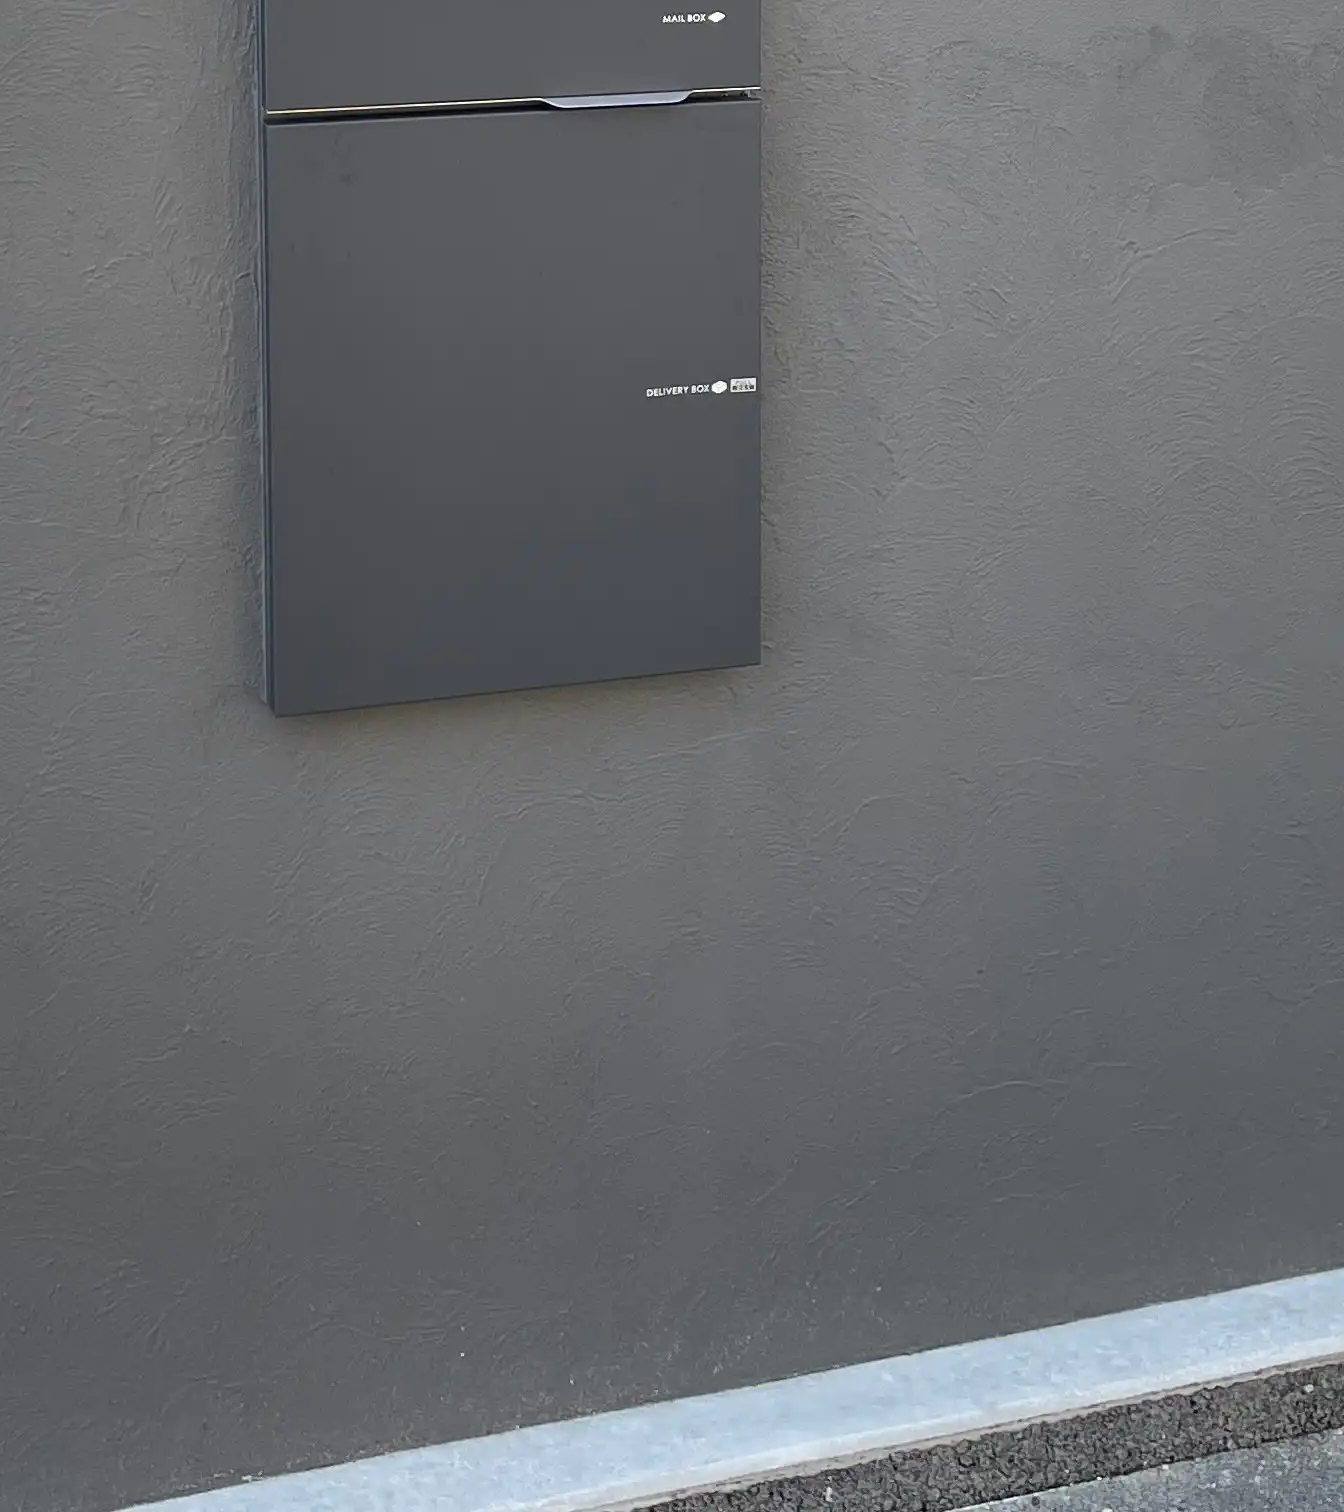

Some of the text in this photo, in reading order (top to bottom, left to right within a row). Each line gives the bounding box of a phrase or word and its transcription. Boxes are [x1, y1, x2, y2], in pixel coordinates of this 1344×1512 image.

[662, 13, 706, 24] MAIL BOX
[646, 384, 710, 398] DELIVERY BOX
